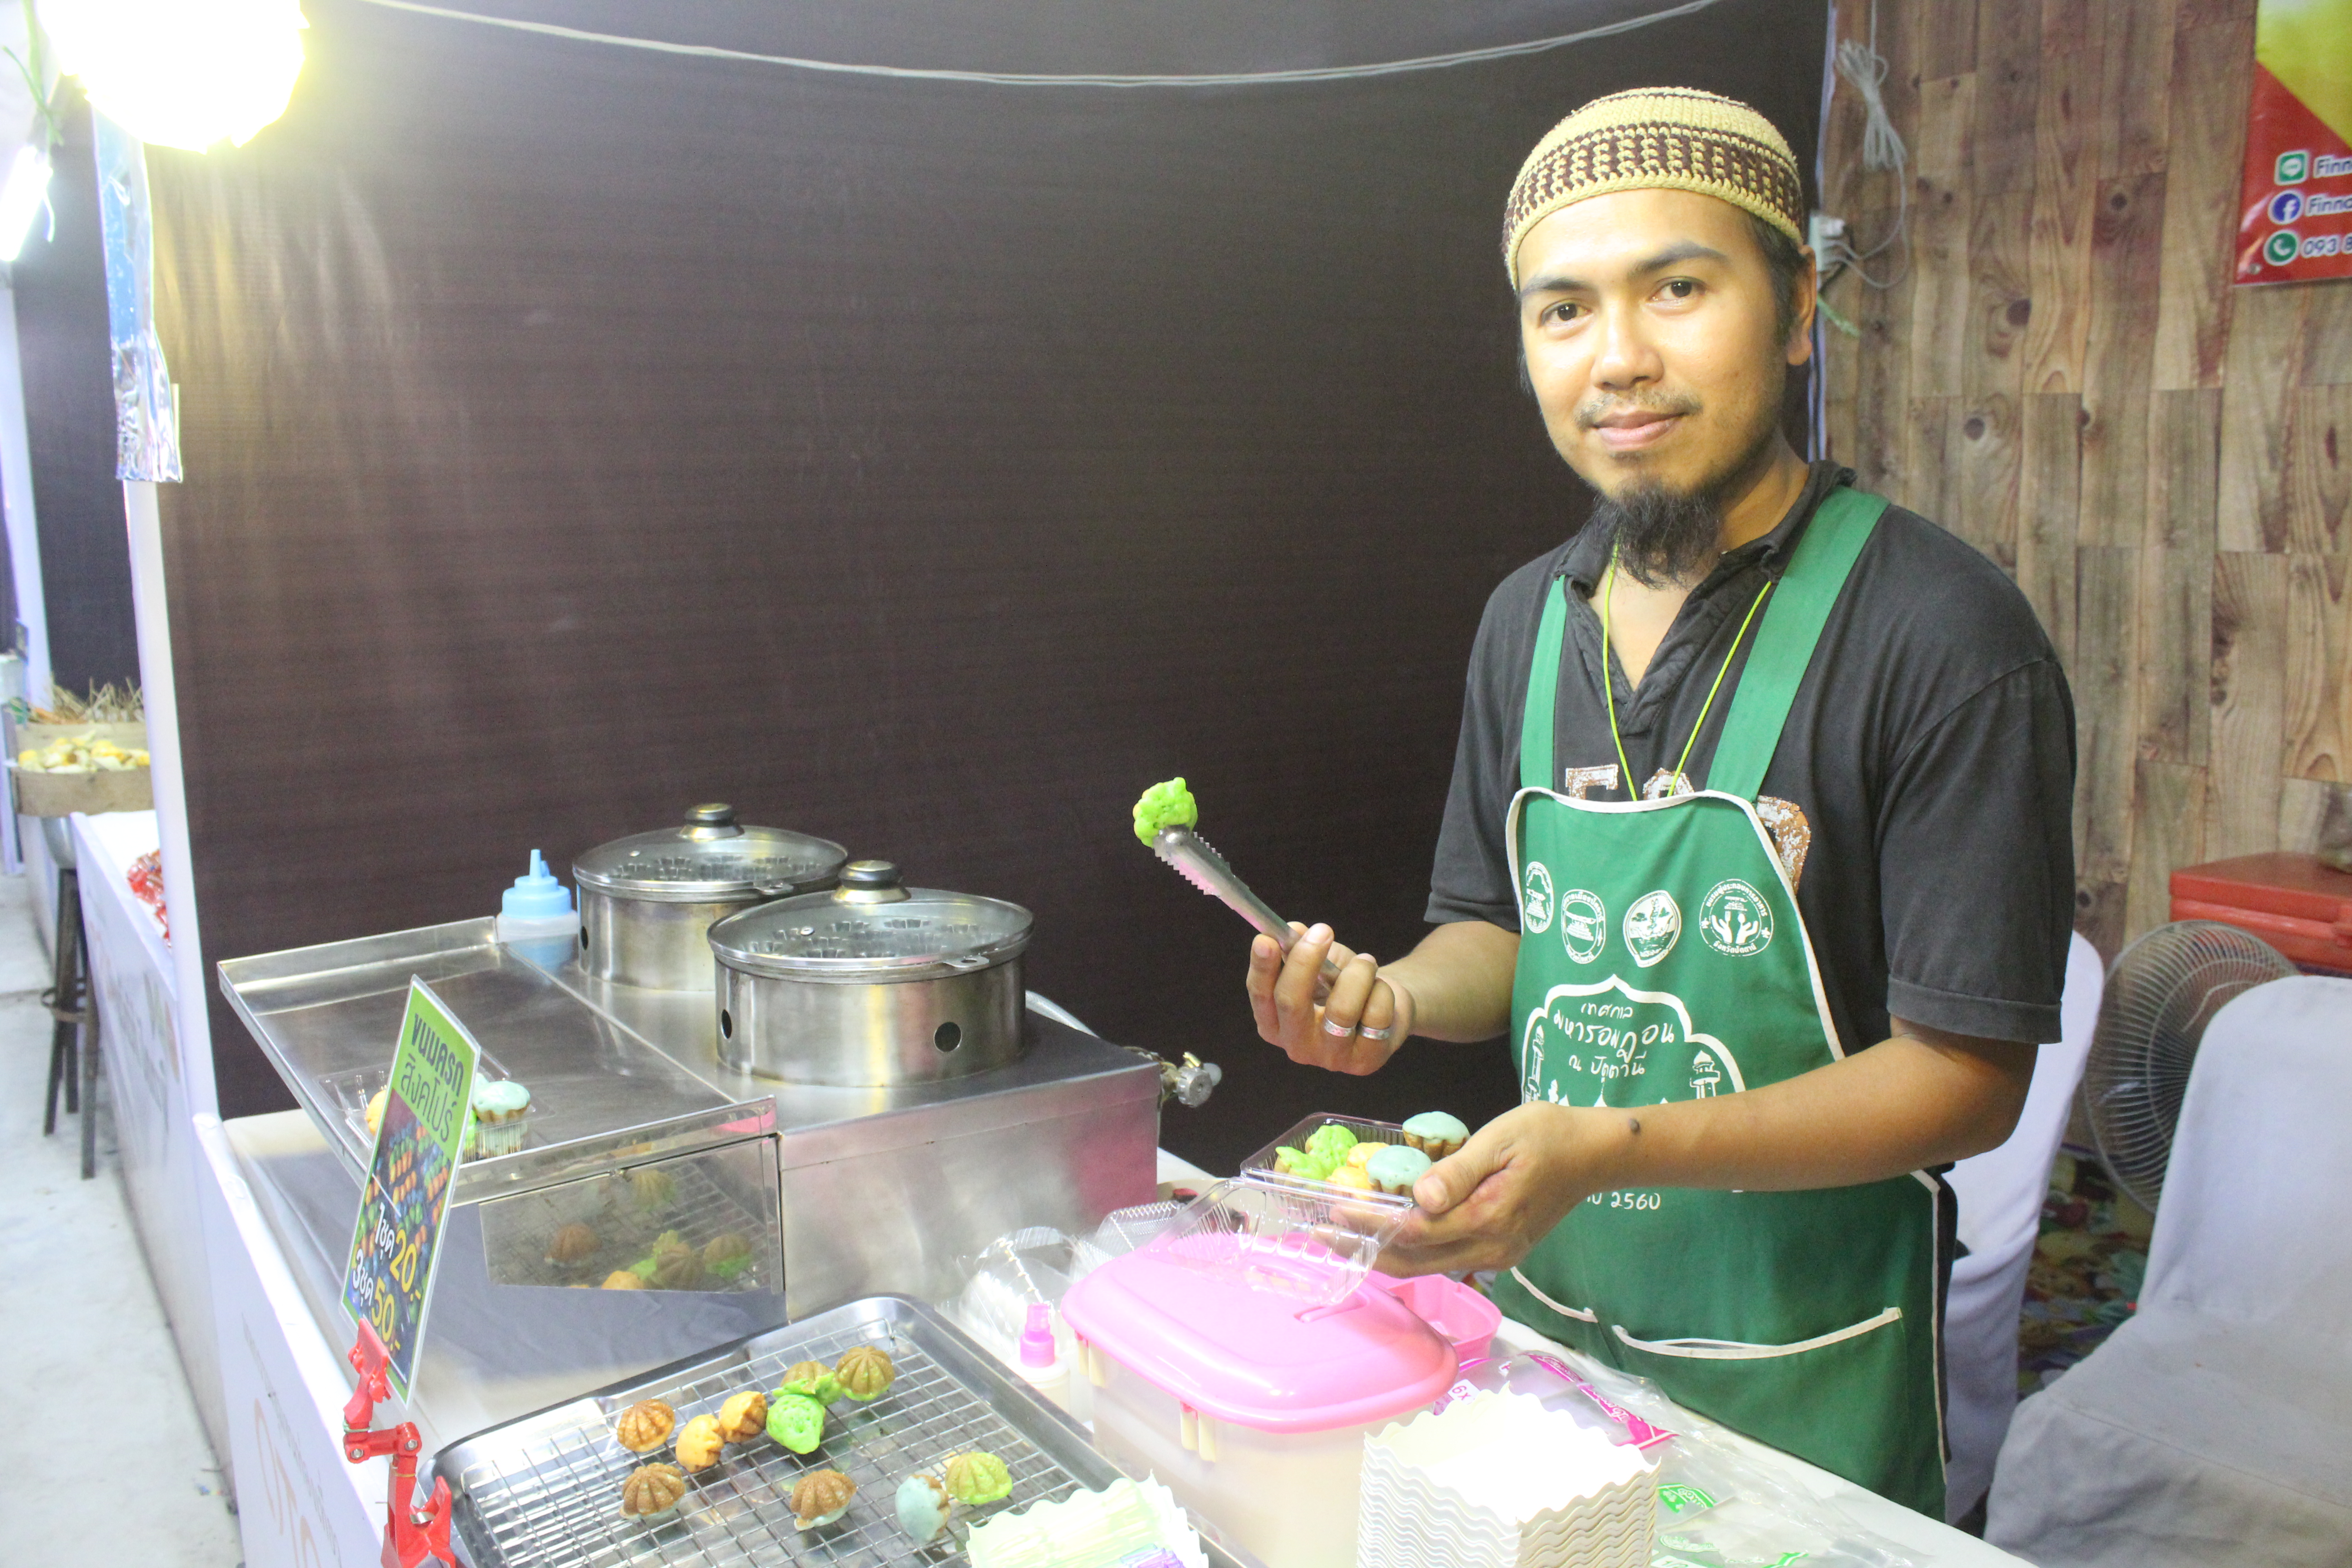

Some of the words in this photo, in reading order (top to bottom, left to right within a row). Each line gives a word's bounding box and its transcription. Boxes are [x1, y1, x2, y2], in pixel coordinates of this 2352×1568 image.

[2304, 237, 2337, 255] 093
[1581, 1003, 1633, 1019] เทศกาล
[411, 1013, 464, 1098] ขนมครก
[1568, 1055, 1582, 1071] ณ
[1591, 1051, 1647, 1079] ปัตตานี
[401, 1053, 457, 1142] สิงคโปร์
[1611, 1191, 1661, 1210] 2560
